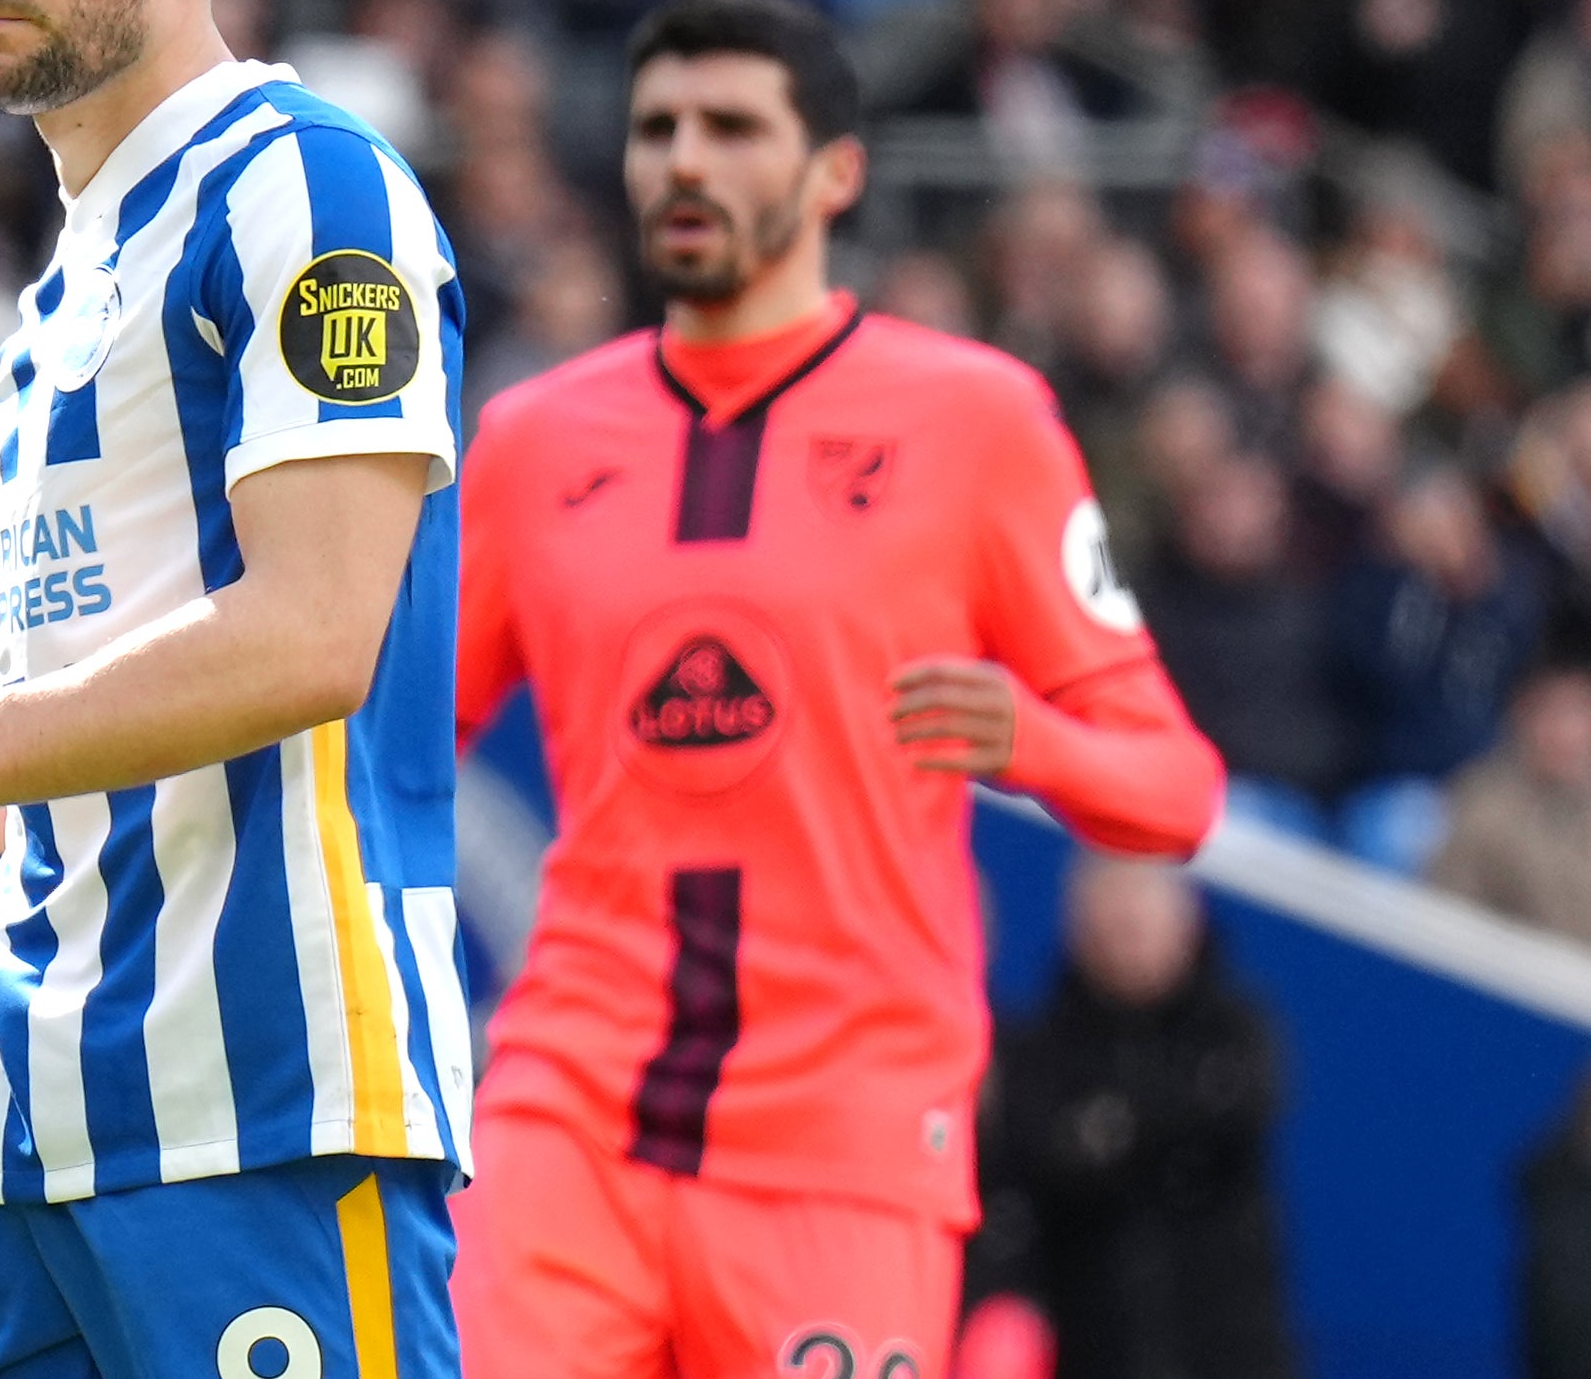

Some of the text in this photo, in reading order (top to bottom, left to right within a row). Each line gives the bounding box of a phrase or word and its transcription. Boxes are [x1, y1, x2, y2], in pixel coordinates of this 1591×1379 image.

[298, 278, 401, 316] SNICKERS
[329, 316, 378, 360] UK
[335, 367, 380, 390] .COM
[635, 693, 774, 741] LOTUS
